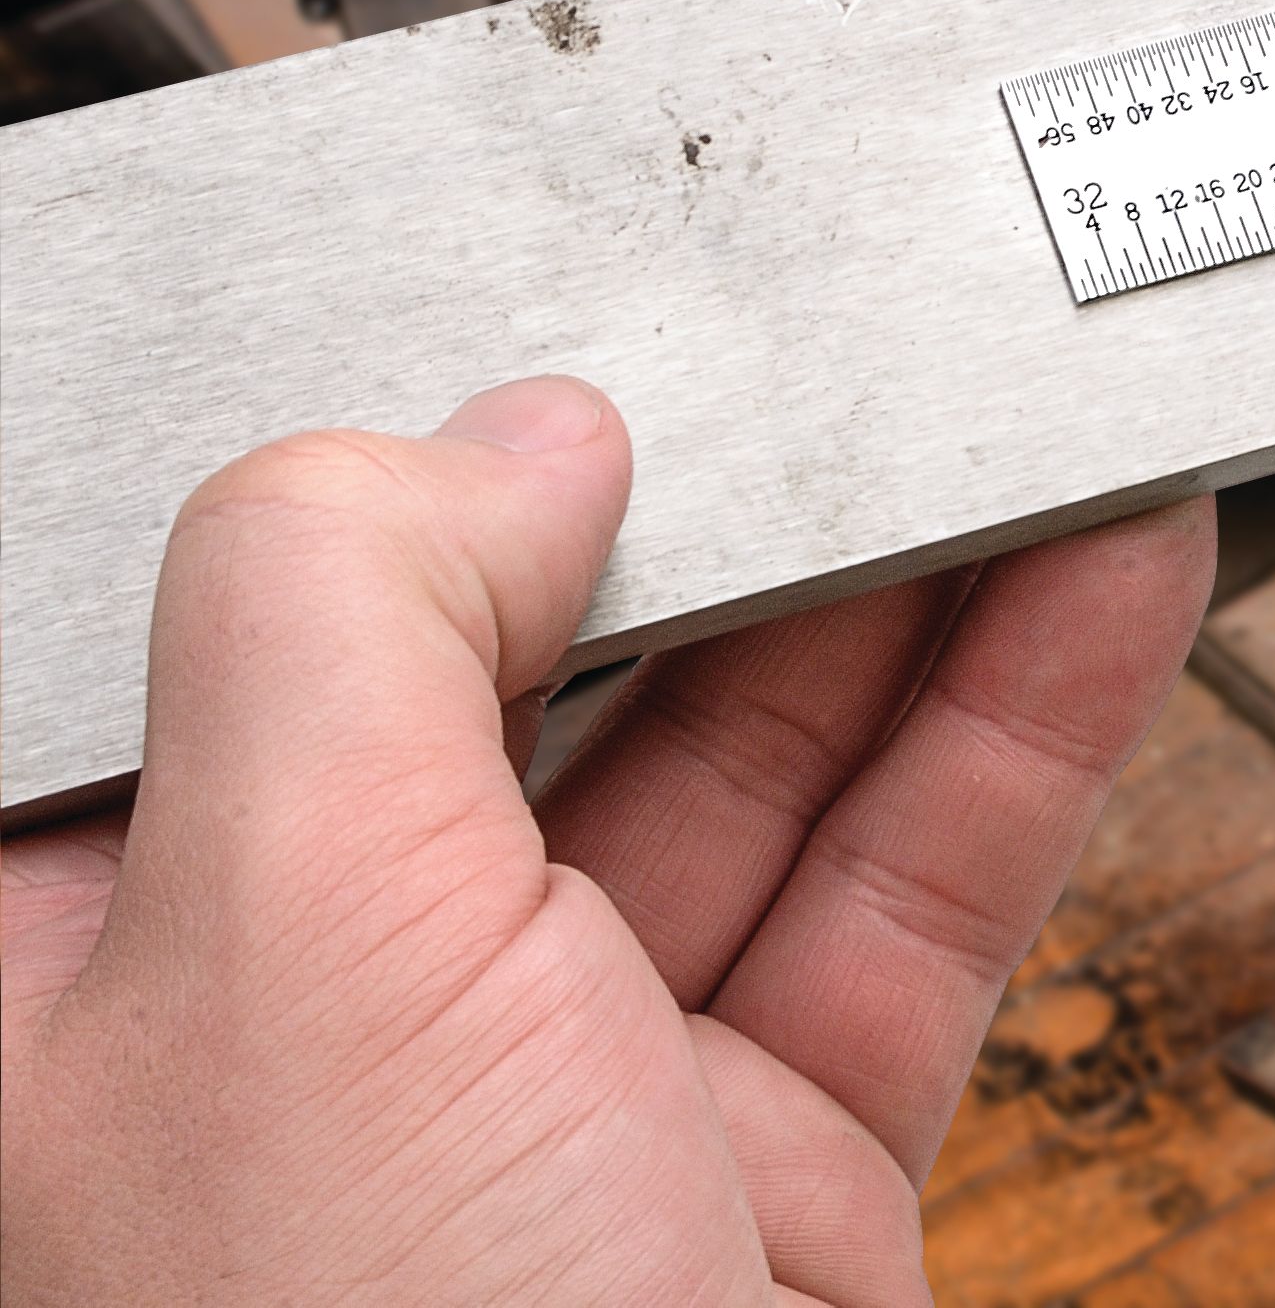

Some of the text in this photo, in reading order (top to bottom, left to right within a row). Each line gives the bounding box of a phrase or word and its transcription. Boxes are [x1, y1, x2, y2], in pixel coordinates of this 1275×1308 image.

[1203, 81, 1233, 104] 24
[1240, 72, 1269, 94] 16
[1127, 103, 1153, 124] 40
[1161, 93, 1192, 114] 32
[1047, 122, 1075, 146] 56
[1087, 113, 1114, 134] 48
[1064, 183, 1107, 214] 32
[1086, 213, 1101, 231] 4
[1125, 203, 1140, 221] 8
[1156, 190, 1188, 213] 12
[1195, 180, 1225, 202] 16
[1233, 170, 1262, 193] 20
